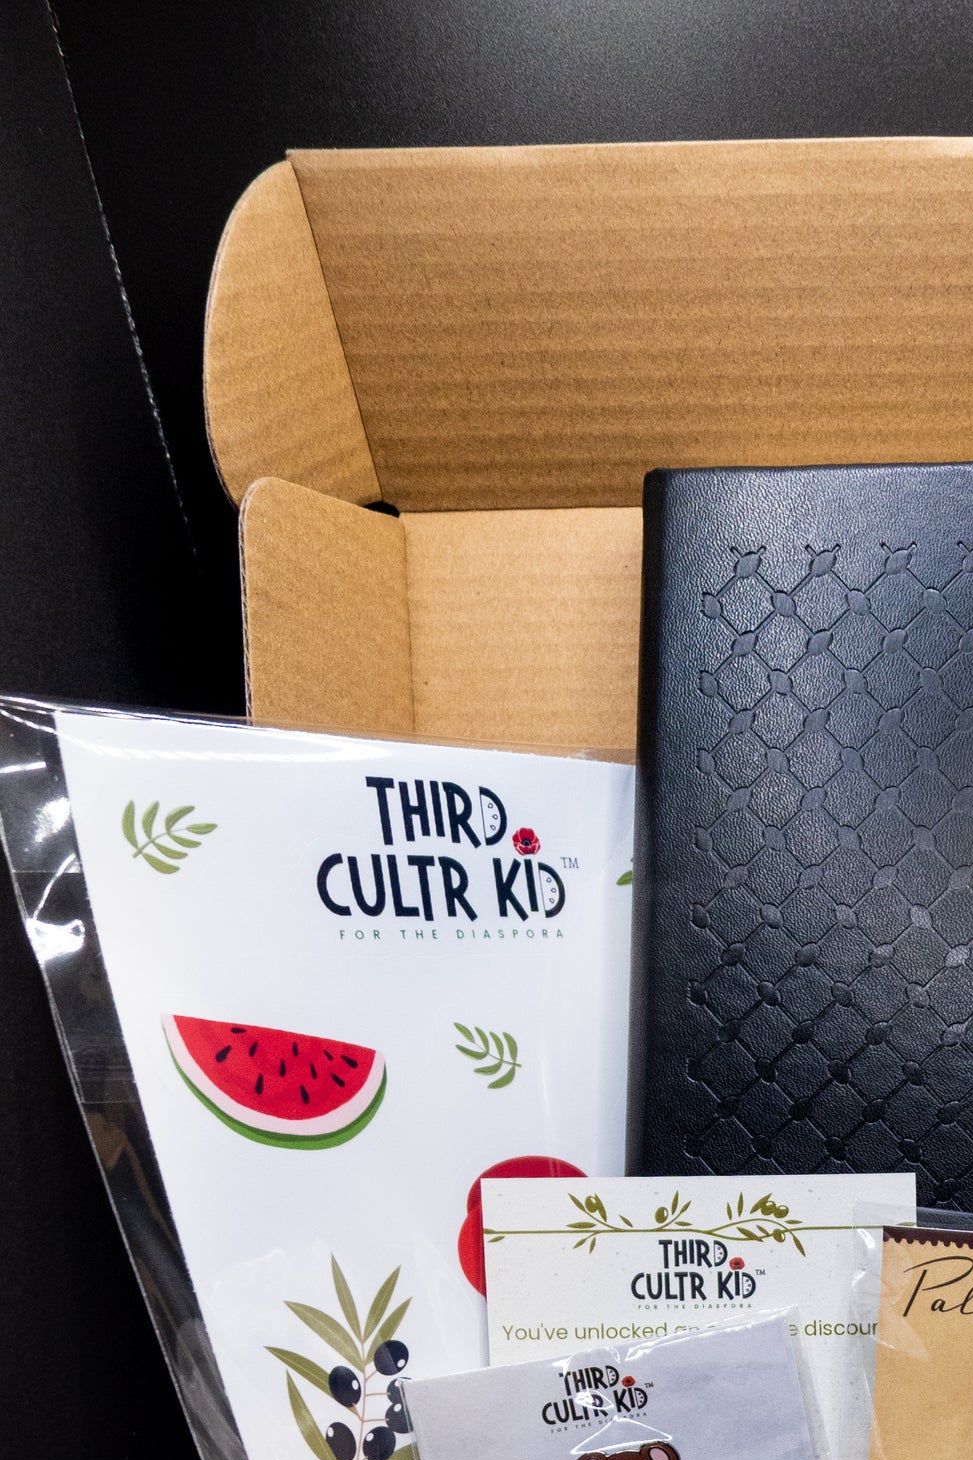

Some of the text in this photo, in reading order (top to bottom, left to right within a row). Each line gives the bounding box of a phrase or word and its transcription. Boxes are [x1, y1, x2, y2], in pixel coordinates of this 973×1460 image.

[366, 776, 507, 848] THIRD
[317, 853, 478, 922] CULTR
[340, 929, 564, 940] FOR THE DIASPORA
[659, 1239, 728, 1268] THIRD
[631, 1272, 706, 1301] CULTR
[502, 1323, 569, 1341] You've
[574, 1322, 668, 1339] unlocked
[558, 1365, 620, 1396] THIRD
